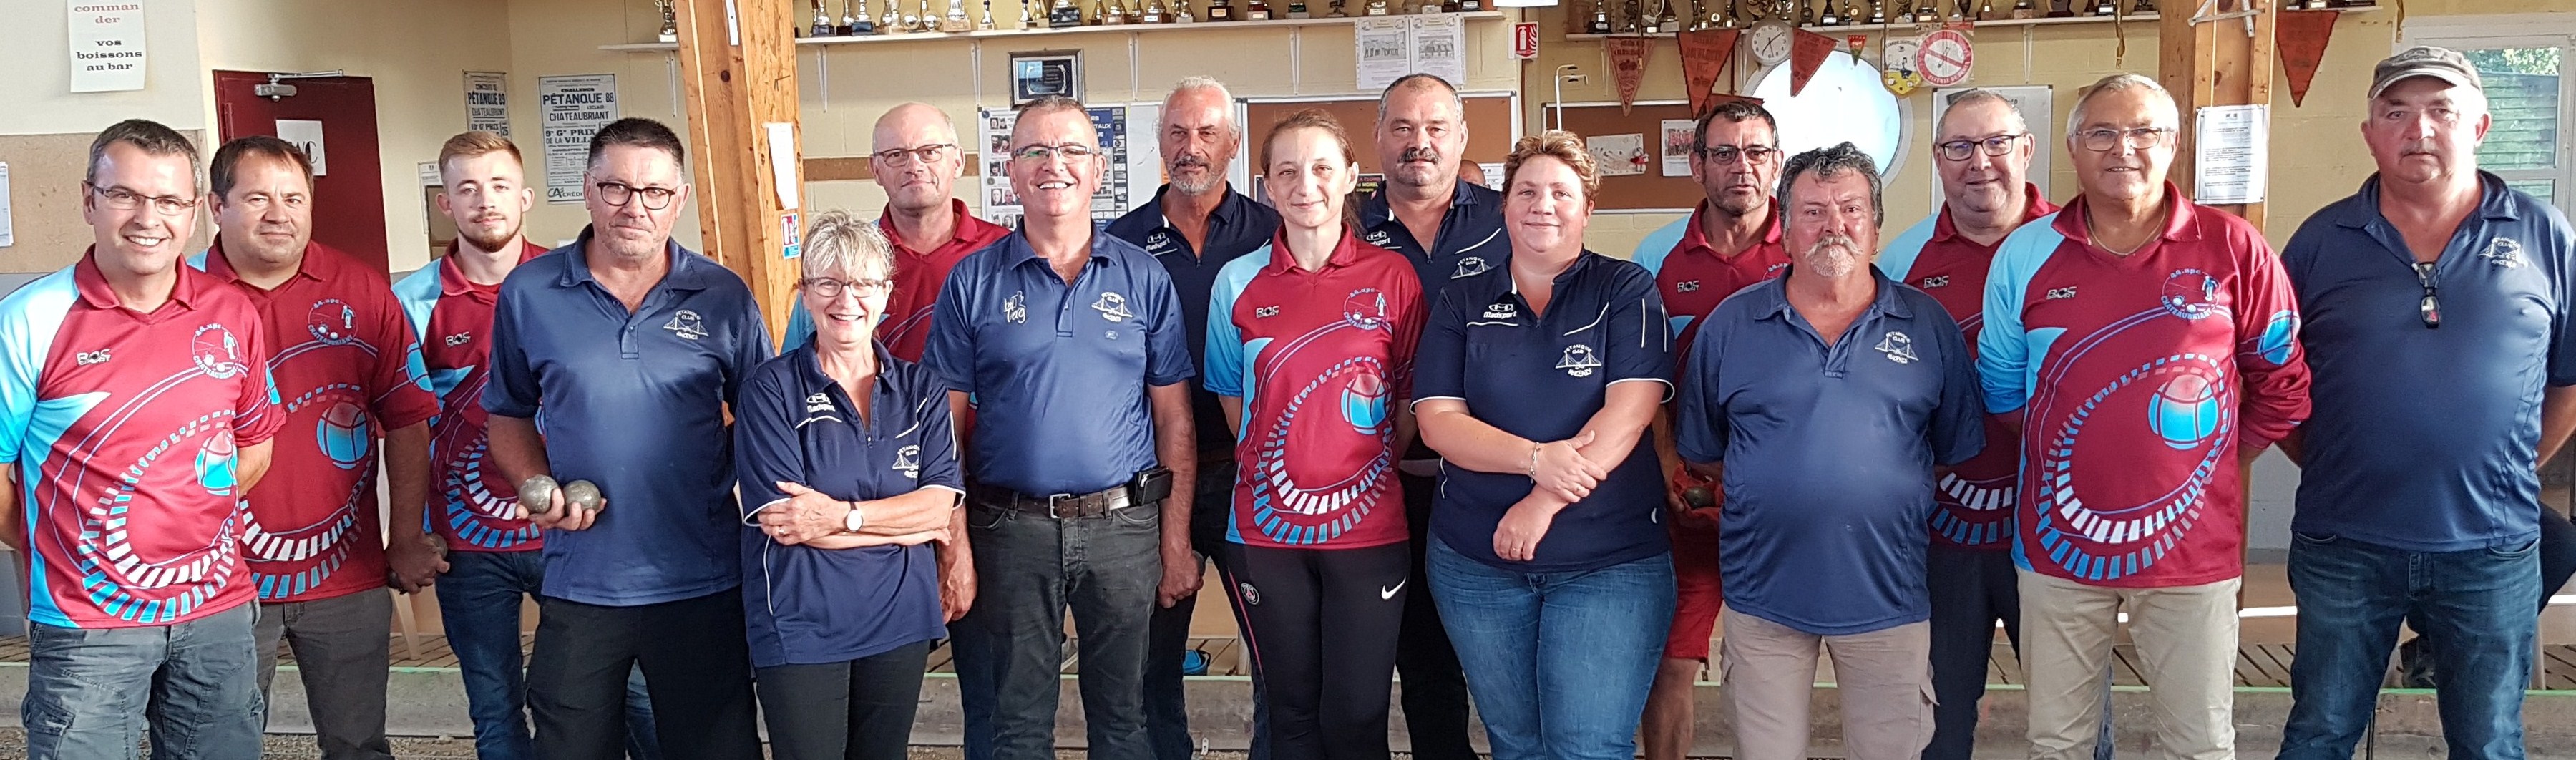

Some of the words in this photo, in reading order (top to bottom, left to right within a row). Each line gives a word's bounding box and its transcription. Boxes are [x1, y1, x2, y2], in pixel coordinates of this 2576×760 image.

[74, 4, 140, 12] comman
[76, 51, 143, 59] boissons
[467, 91, 498, 105] PÉTANQUE
[542, 92, 603, 105] PÉTANQUE
[605, 92, 614, 103] 88
[549, 111, 610, 122] CHATEAUBRIANT
